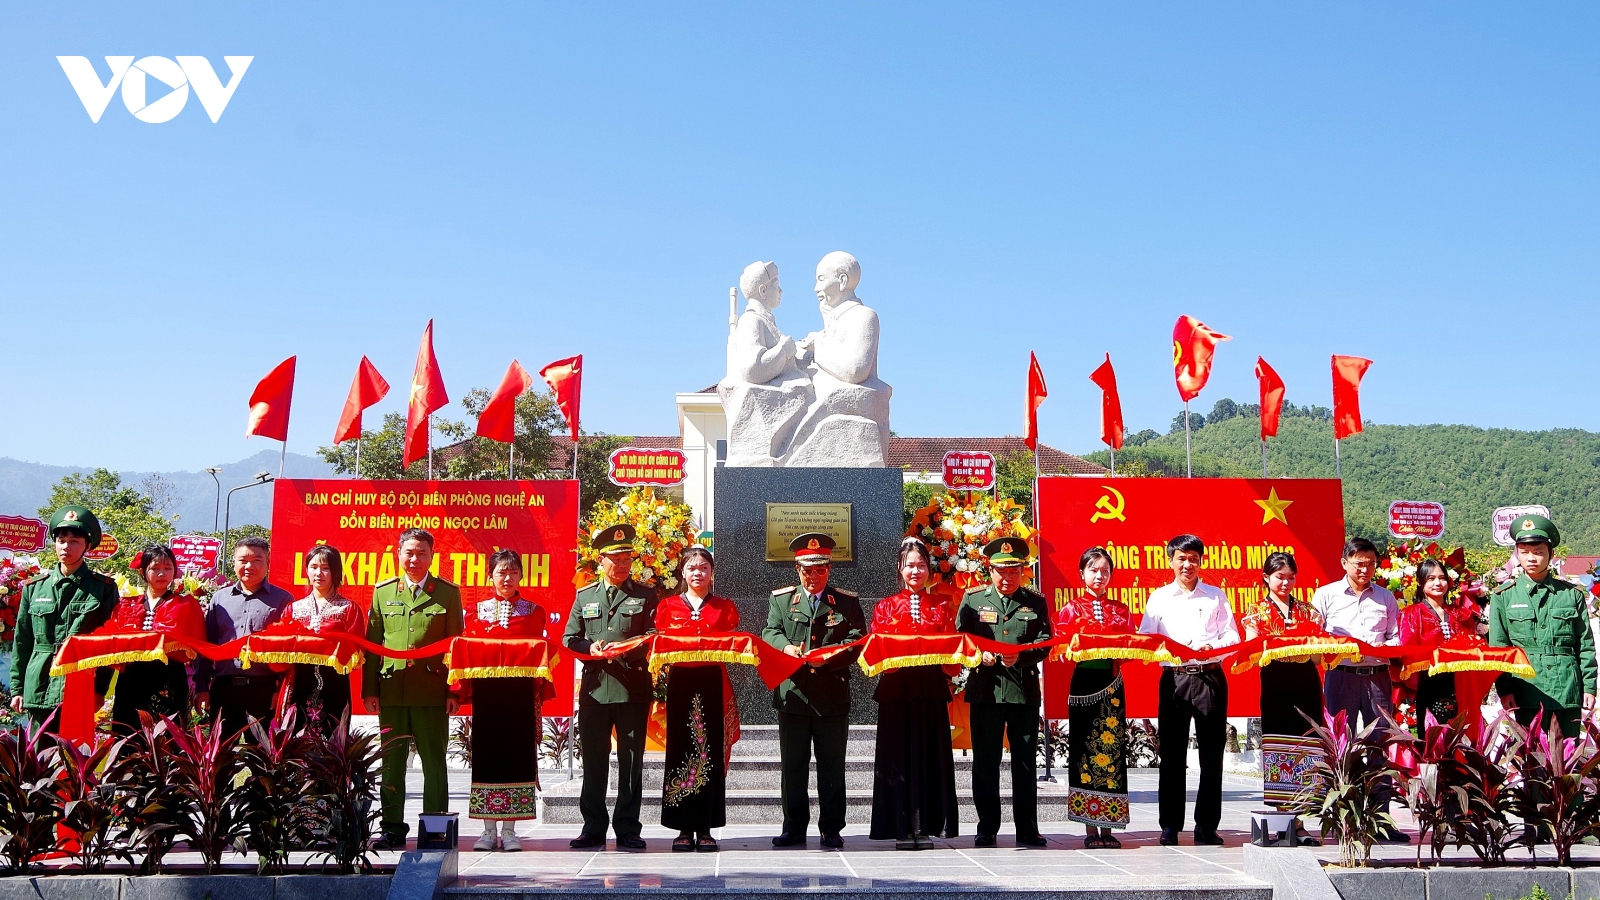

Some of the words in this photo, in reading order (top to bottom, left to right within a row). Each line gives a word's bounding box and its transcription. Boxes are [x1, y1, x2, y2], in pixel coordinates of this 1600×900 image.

[670, 456, 678, 465] LAO
[952, 476, 966, 484] Chúc
[967, 476, 984, 486] Mừng
[305, 493, 328, 505] BAN
[331, 489, 352, 505] CHỈ
[355, 494, 377, 505] HUY
[380, 490, 396, 508] BỘ
[399, 490, 419, 508] ĐỘI
[423, 491, 447, 505] BIÊN
[450, 491, 491, 506] PHÒNG
[495, 491, 525, 509] NGHỆ
[528, 495, 544, 506] AN
[340, 510, 366, 528] ĐỒN
[370, 513, 394, 528] BIÊN
[398, 513, 440, 529] PHÒNG
[444, 516, 480, 532] NGỌC
[484, 514, 508, 529] LÂM
[14, 538, 35, 549] Mừng
[294, 539, 327, 585] L
[342, 545, 440, 586] KHÁ
[450, 546, 550, 587] THH
[1096, 541, 1140, 570] ÔNG
[1144, 541, 1174, 570] TRÌ
[1201, 541, 1242, 569] CHÀO
